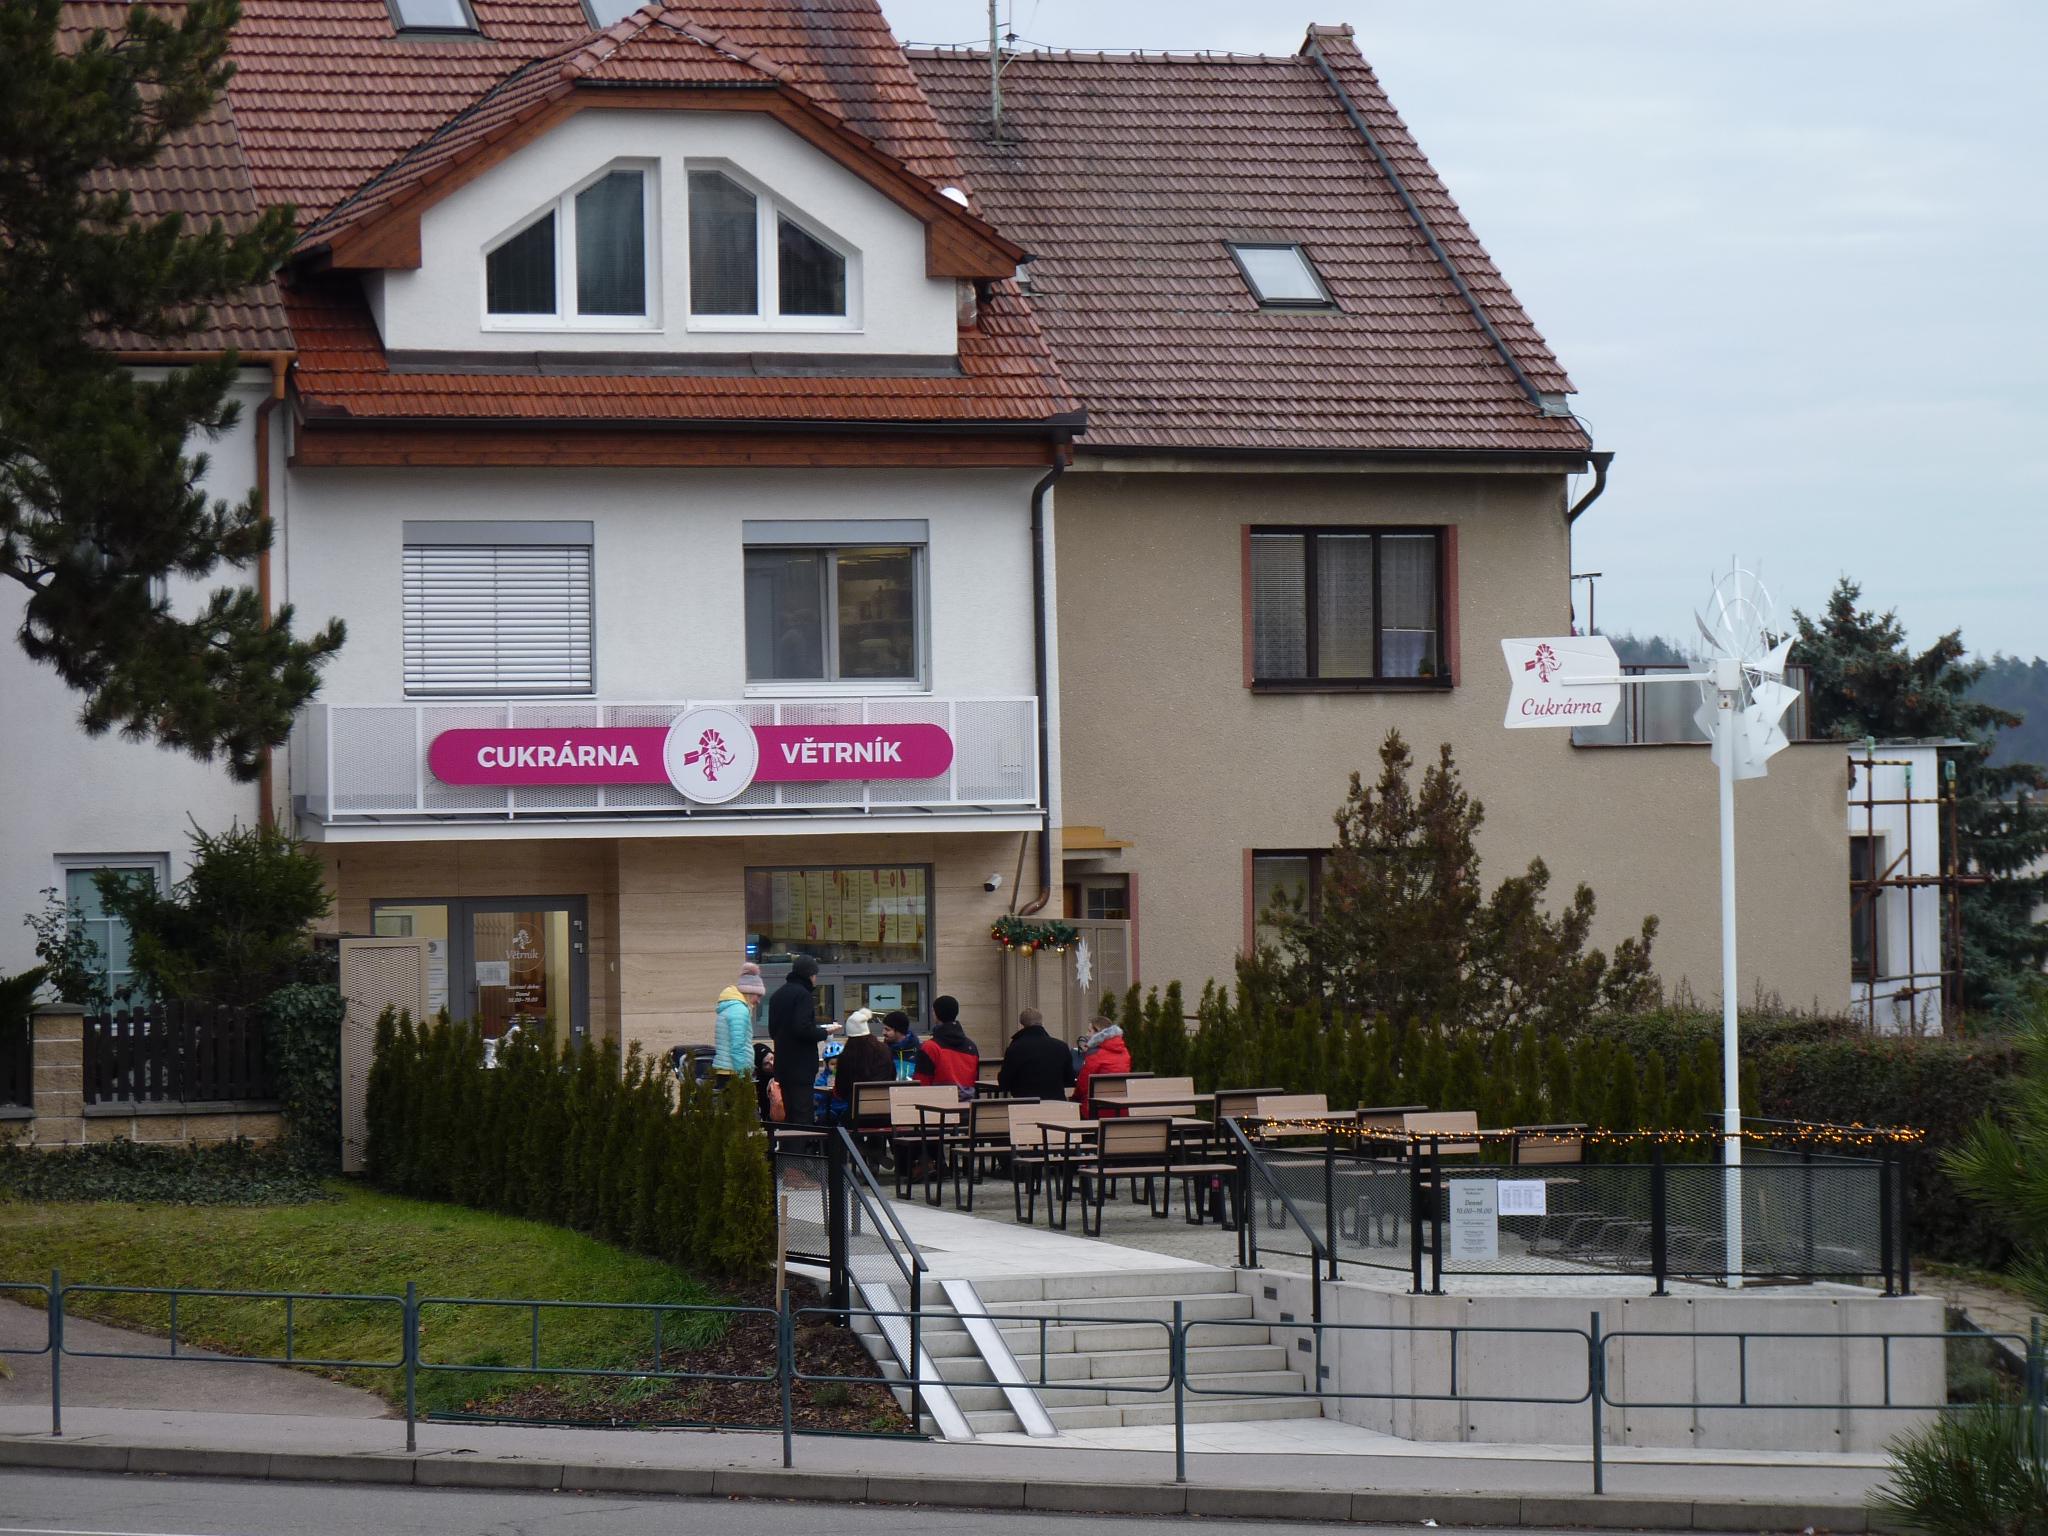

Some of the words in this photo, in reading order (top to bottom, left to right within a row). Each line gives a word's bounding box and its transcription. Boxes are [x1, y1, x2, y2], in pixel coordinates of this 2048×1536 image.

[1521, 697, 1602, 716] Cukrárna
[477, 740, 639, 768] CUKRÁRNA
[780, 736, 902, 764] VĚTRNÍK
